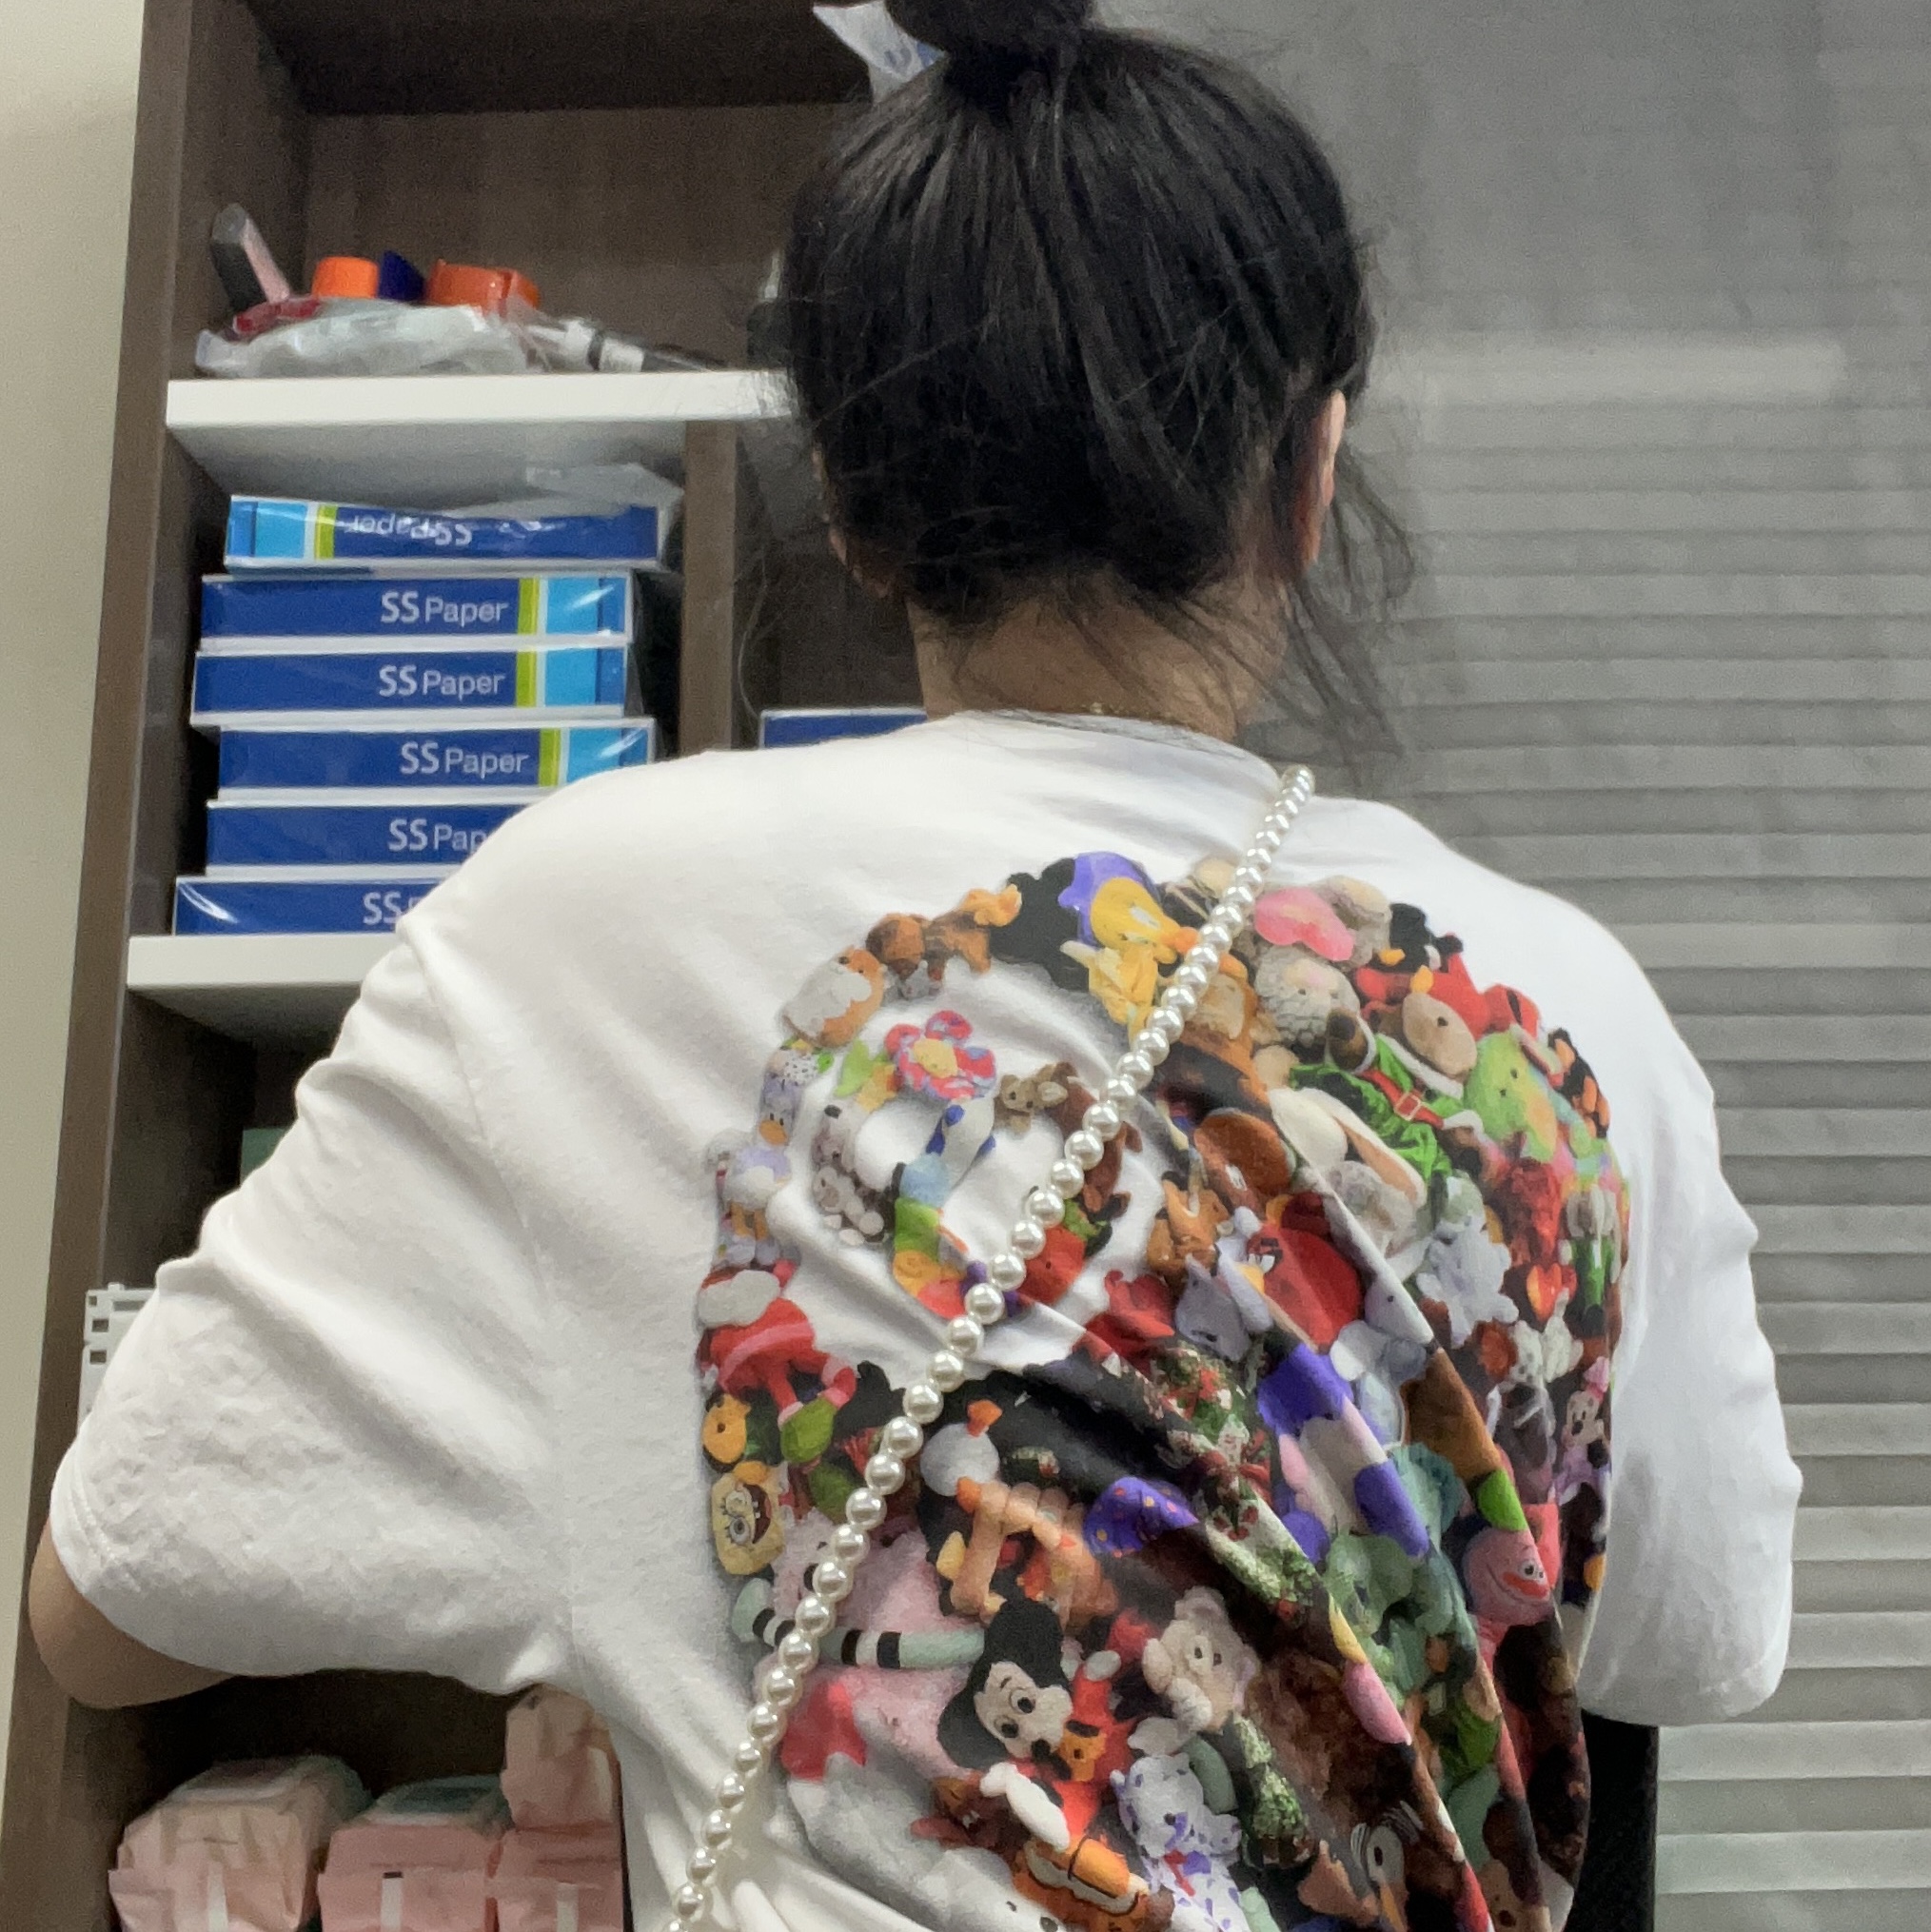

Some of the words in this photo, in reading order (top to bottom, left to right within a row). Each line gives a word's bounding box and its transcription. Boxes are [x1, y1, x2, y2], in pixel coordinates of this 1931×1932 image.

[381, 591, 420, 623] SS
[425, 596, 509, 628] Paper
[379, 664, 418, 697] SS
[423, 670, 505, 701] Paper
[400, 740, 440, 775] SS
[444, 747, 529, 779] Paper
[387, 818, 428, 852] SS
[433, 823, 487, 854] Pap
[363, 892, 403, 925] SS
